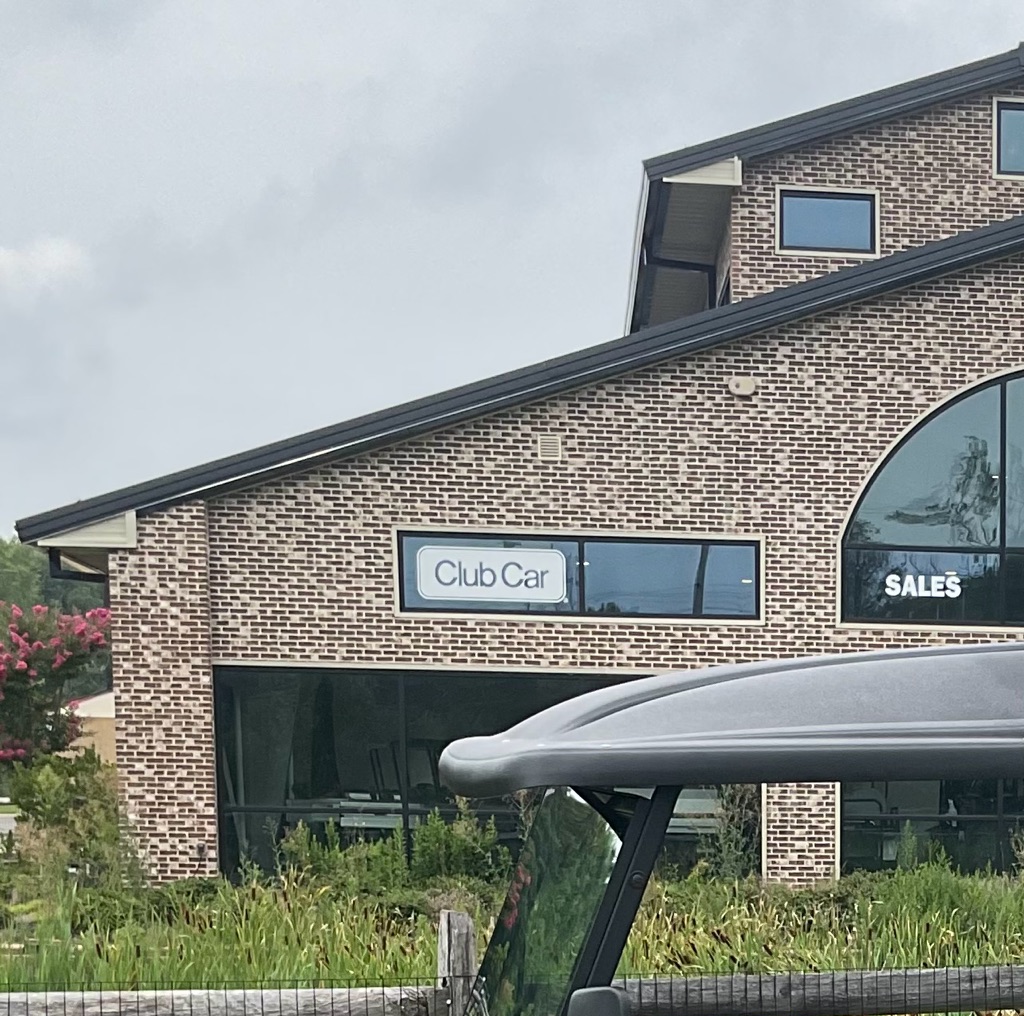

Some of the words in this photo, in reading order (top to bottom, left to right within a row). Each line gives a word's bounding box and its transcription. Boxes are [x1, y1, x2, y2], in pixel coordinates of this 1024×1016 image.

[434, 559, 497, 588] Club
[501, 561, 549, 590] Car
[884, 573, 961, 598] SALES
